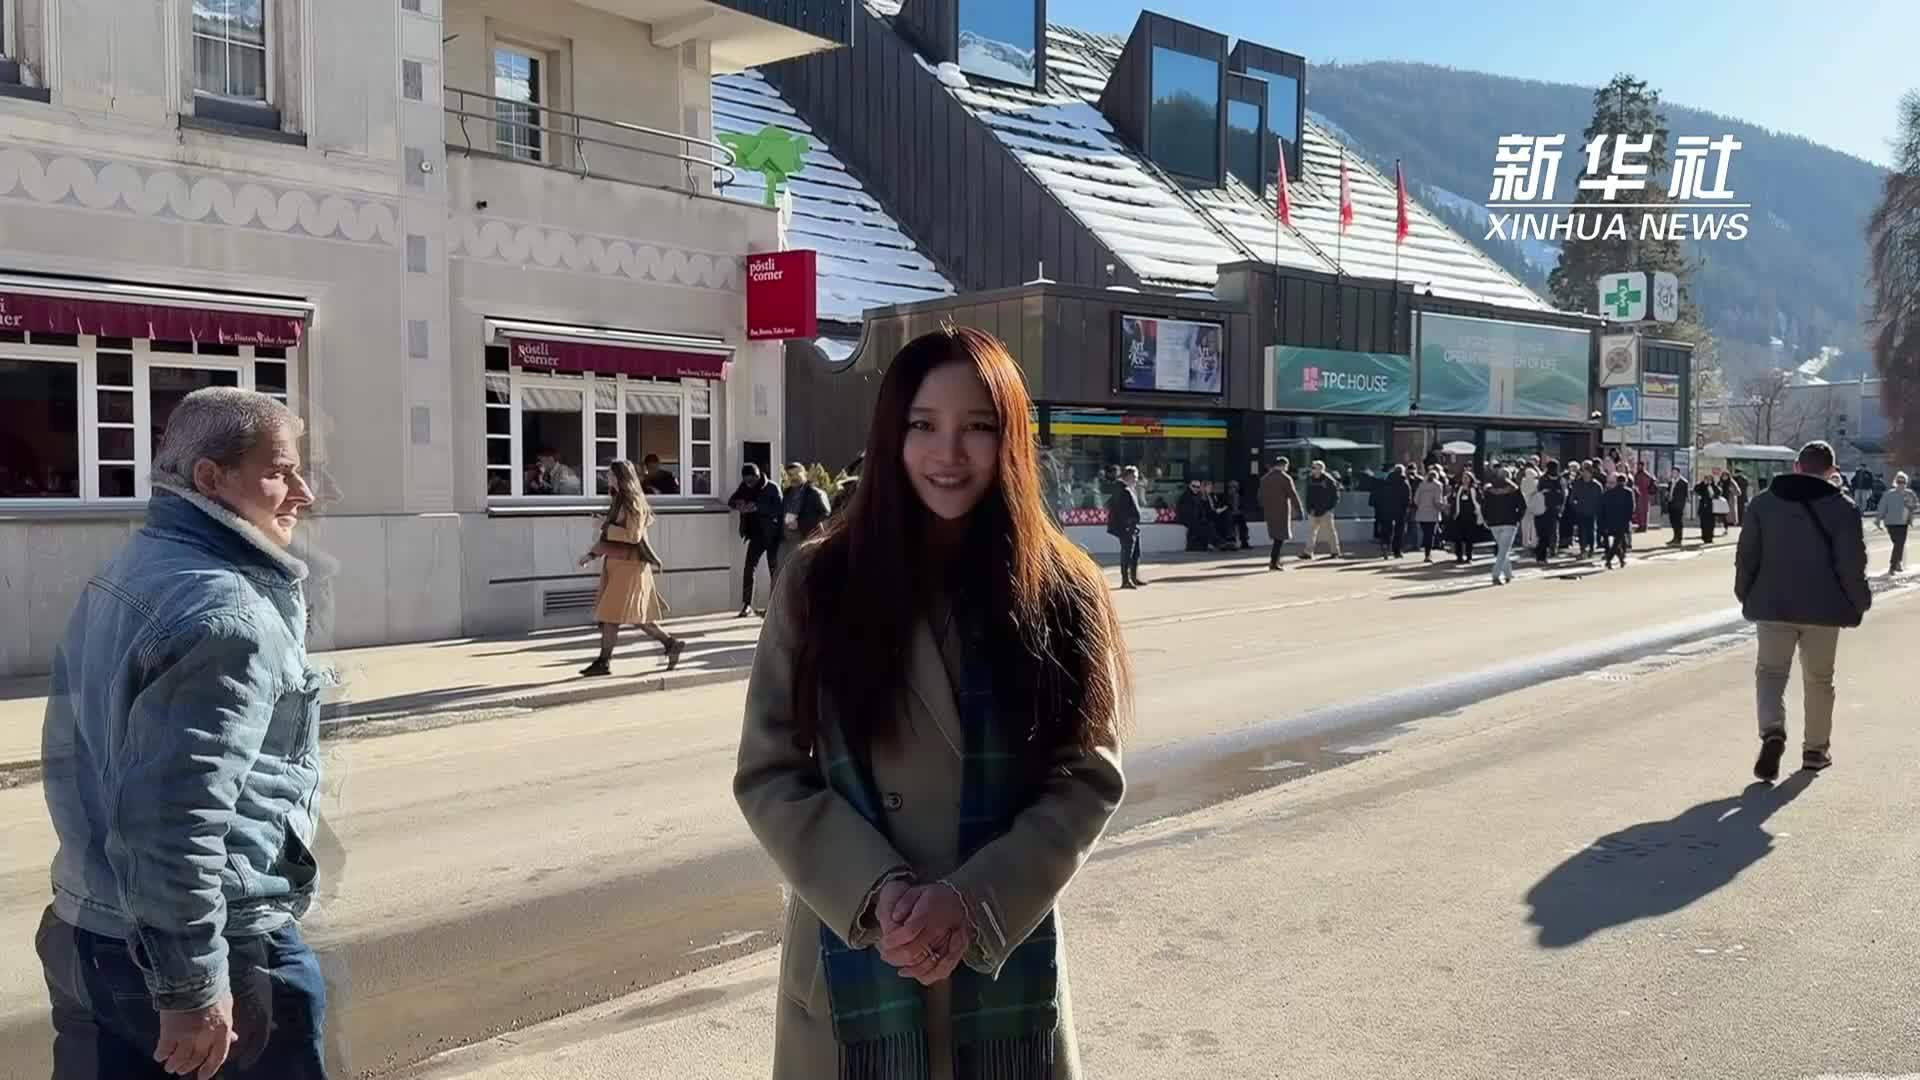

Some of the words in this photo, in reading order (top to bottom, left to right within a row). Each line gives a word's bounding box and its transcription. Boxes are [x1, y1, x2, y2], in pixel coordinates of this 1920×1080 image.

[750, 257, 775, 277] pöstli
[753, 270, 784, 281] corner
[523, 354, 560, 367] corner
[1321, 371, 1346, 390] TPC
[1347, 373, 1389, 393] HOUSE
